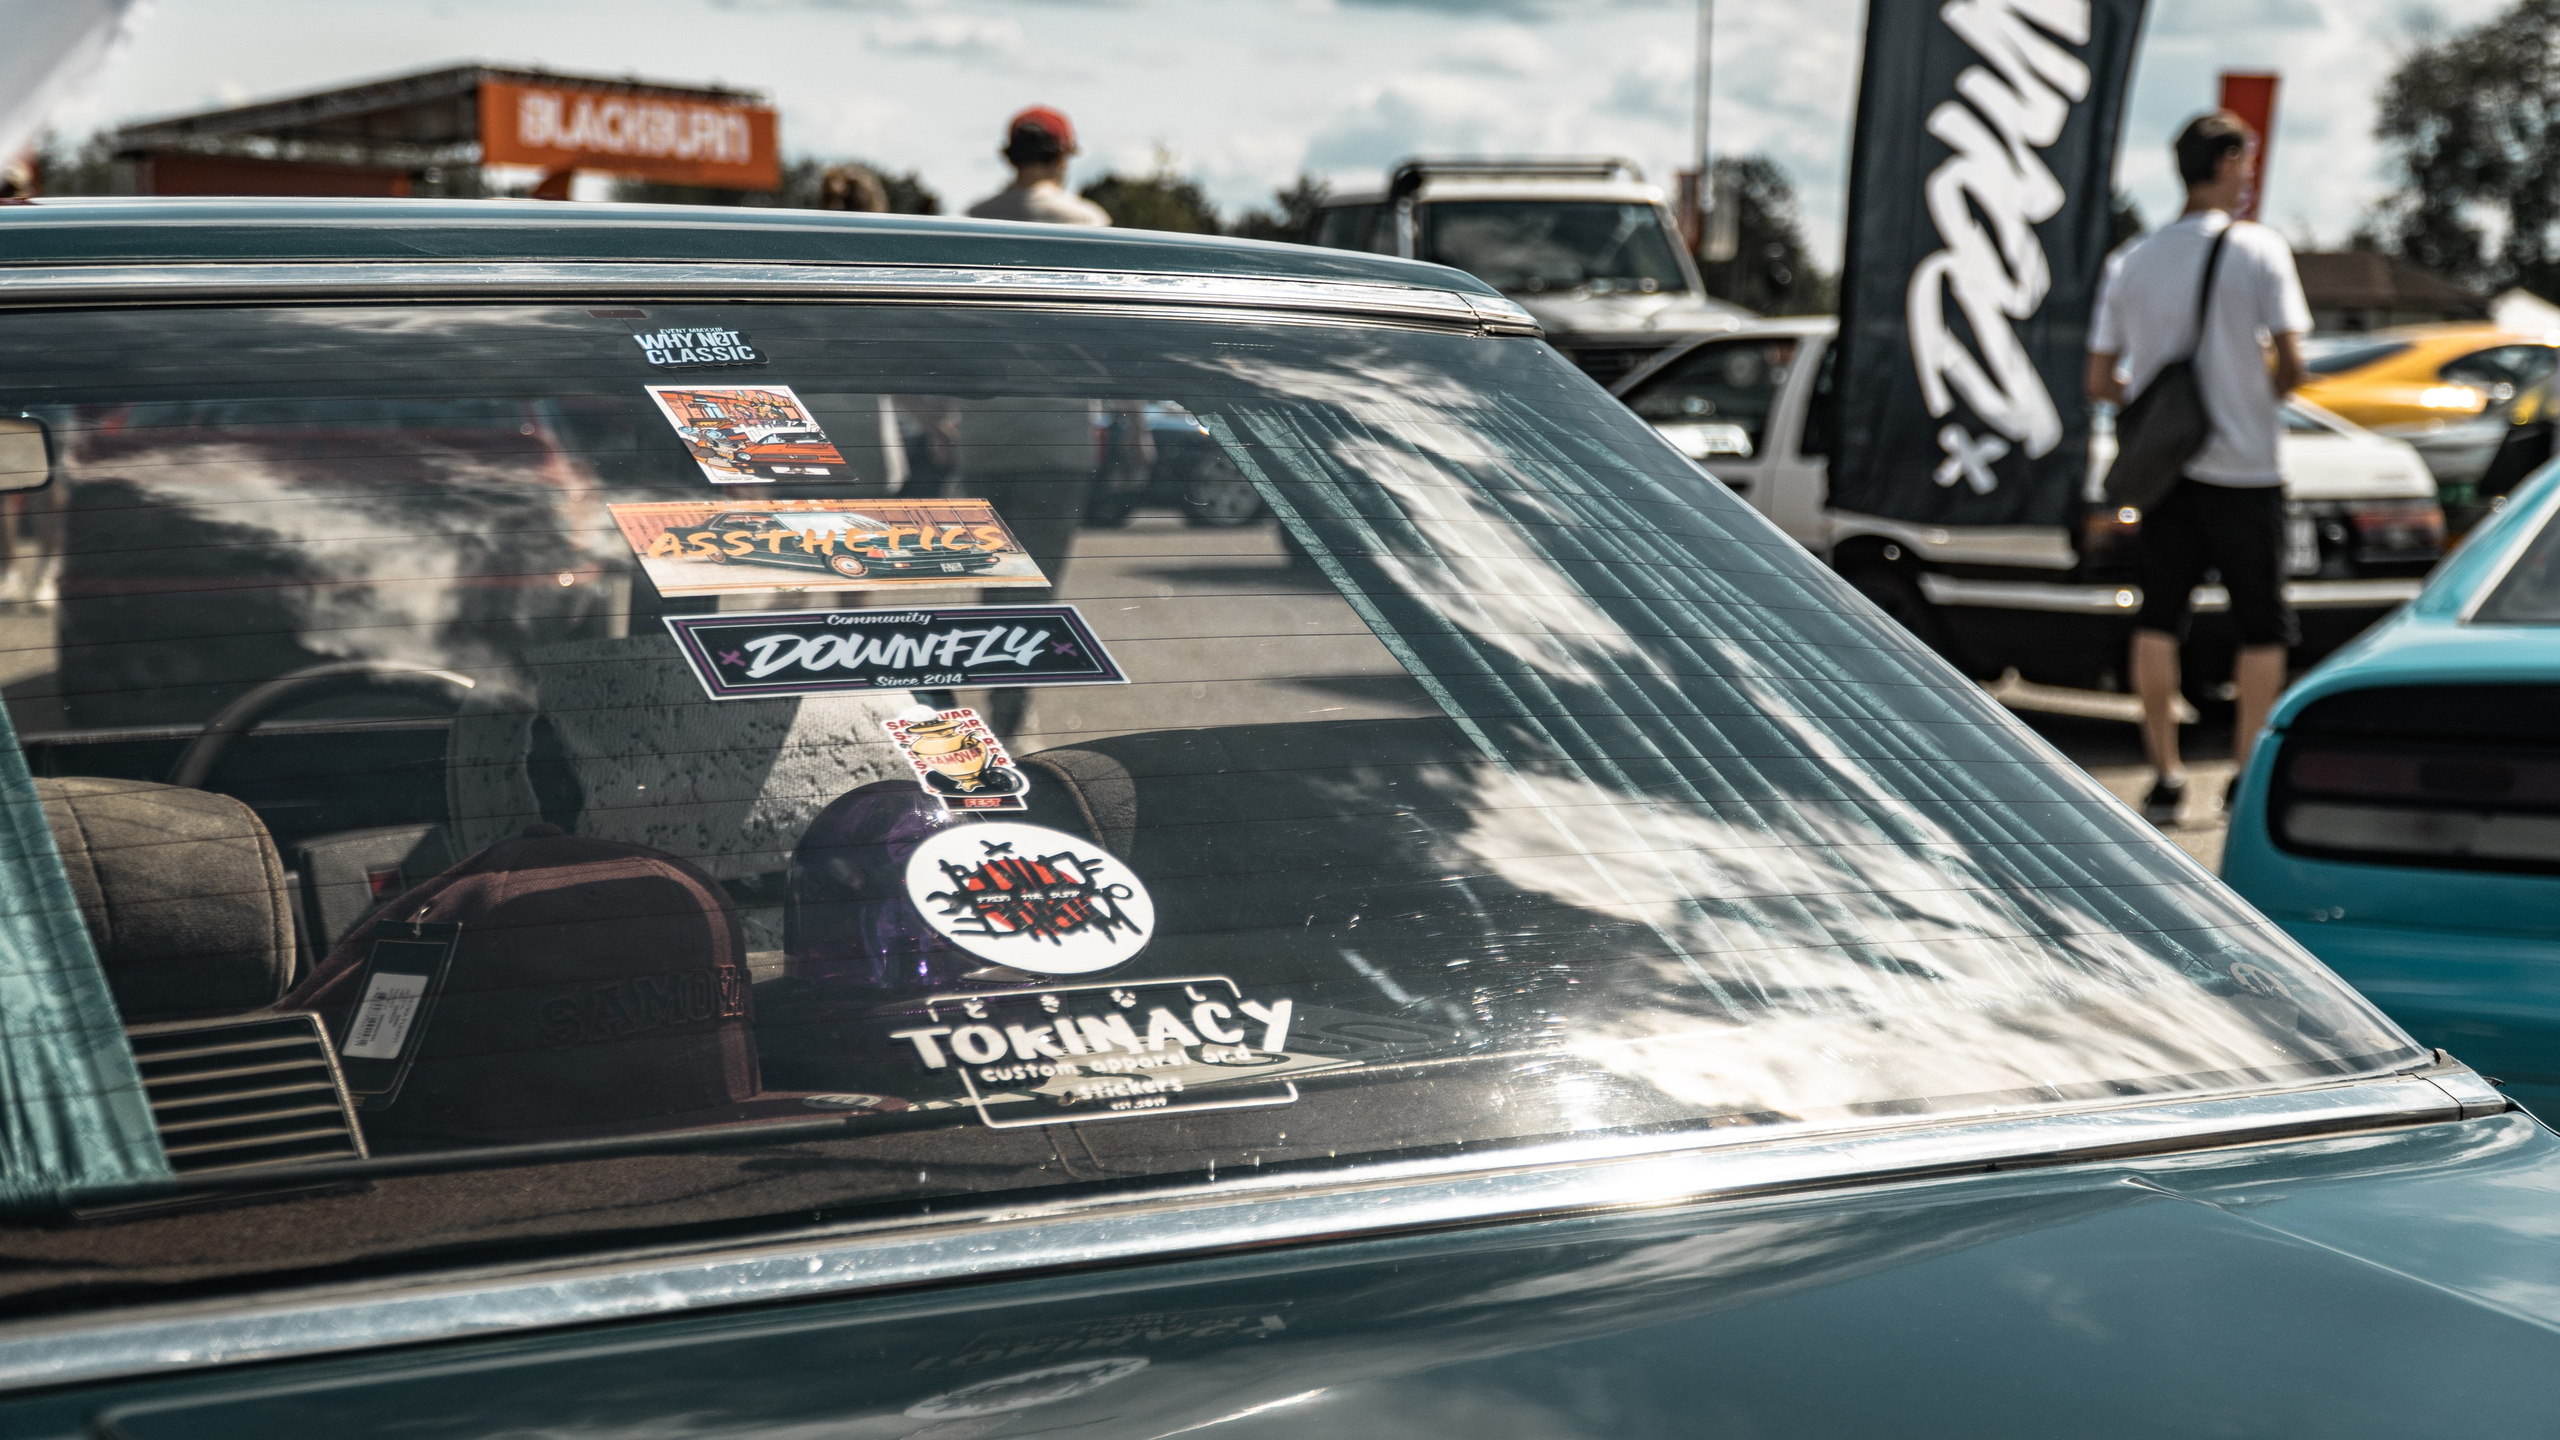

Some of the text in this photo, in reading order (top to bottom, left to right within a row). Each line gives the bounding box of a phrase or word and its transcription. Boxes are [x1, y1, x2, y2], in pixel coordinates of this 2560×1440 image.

[634, 332, 693, 350] WHY
[646, 346, 756, 365] CLASSIC
[826, 611, 932, 627] Community
[745, 626, 1050, 678] DOWNFLY
[875, 673, 965, 687] Since 2014
[927, 748, 983, 765] SAMOVAR
[964, 798, 1002, 808] FEST
[980, 1060, 1079, 1083] custom
[1089, 1048, 1191, 1074] apparel
[1077, 1076, 1184, 1100] stickers
